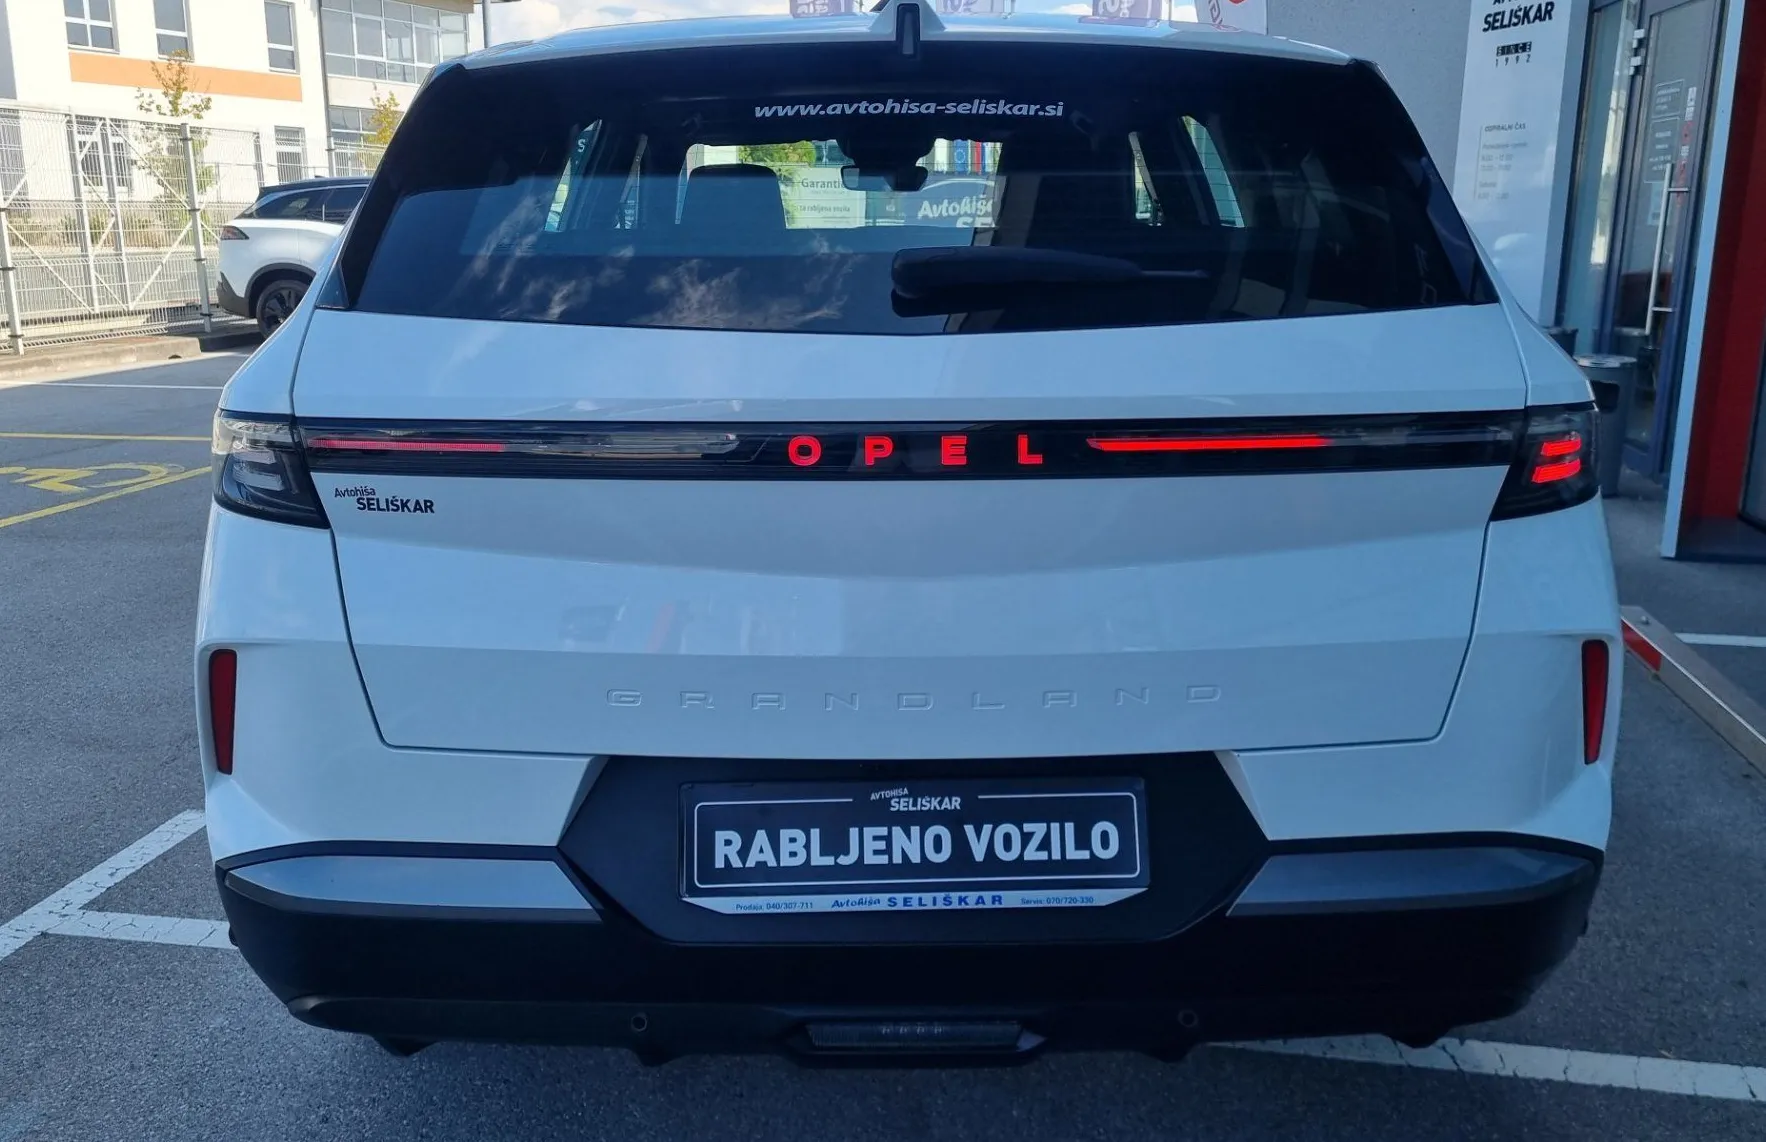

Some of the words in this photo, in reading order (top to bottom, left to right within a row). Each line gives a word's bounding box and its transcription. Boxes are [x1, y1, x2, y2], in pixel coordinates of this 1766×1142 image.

[1482, 1, 1555, 33] SELIŠKAR
[1495, 54, 1532, 68] 1992
[754, 99, 1065, 119] www.avtohisa-seliskar.si
[787, 434, 1044, 467] OPEL
[334, 485, 376, 498] Avtohiša
[356, 495, 435, 514] SELIŠKAR
[606, 685, 1223, 712] GRANDLAND
[890, 796, 961, 812] SELIŠKAR
[714, 824, 952, 869] RABLJENO
[963, 820, 1120, 863] VOZILO
[766, 901, 814, 911] 040/307-711
[887, 894, 1003, 907] SELIŠKAR
